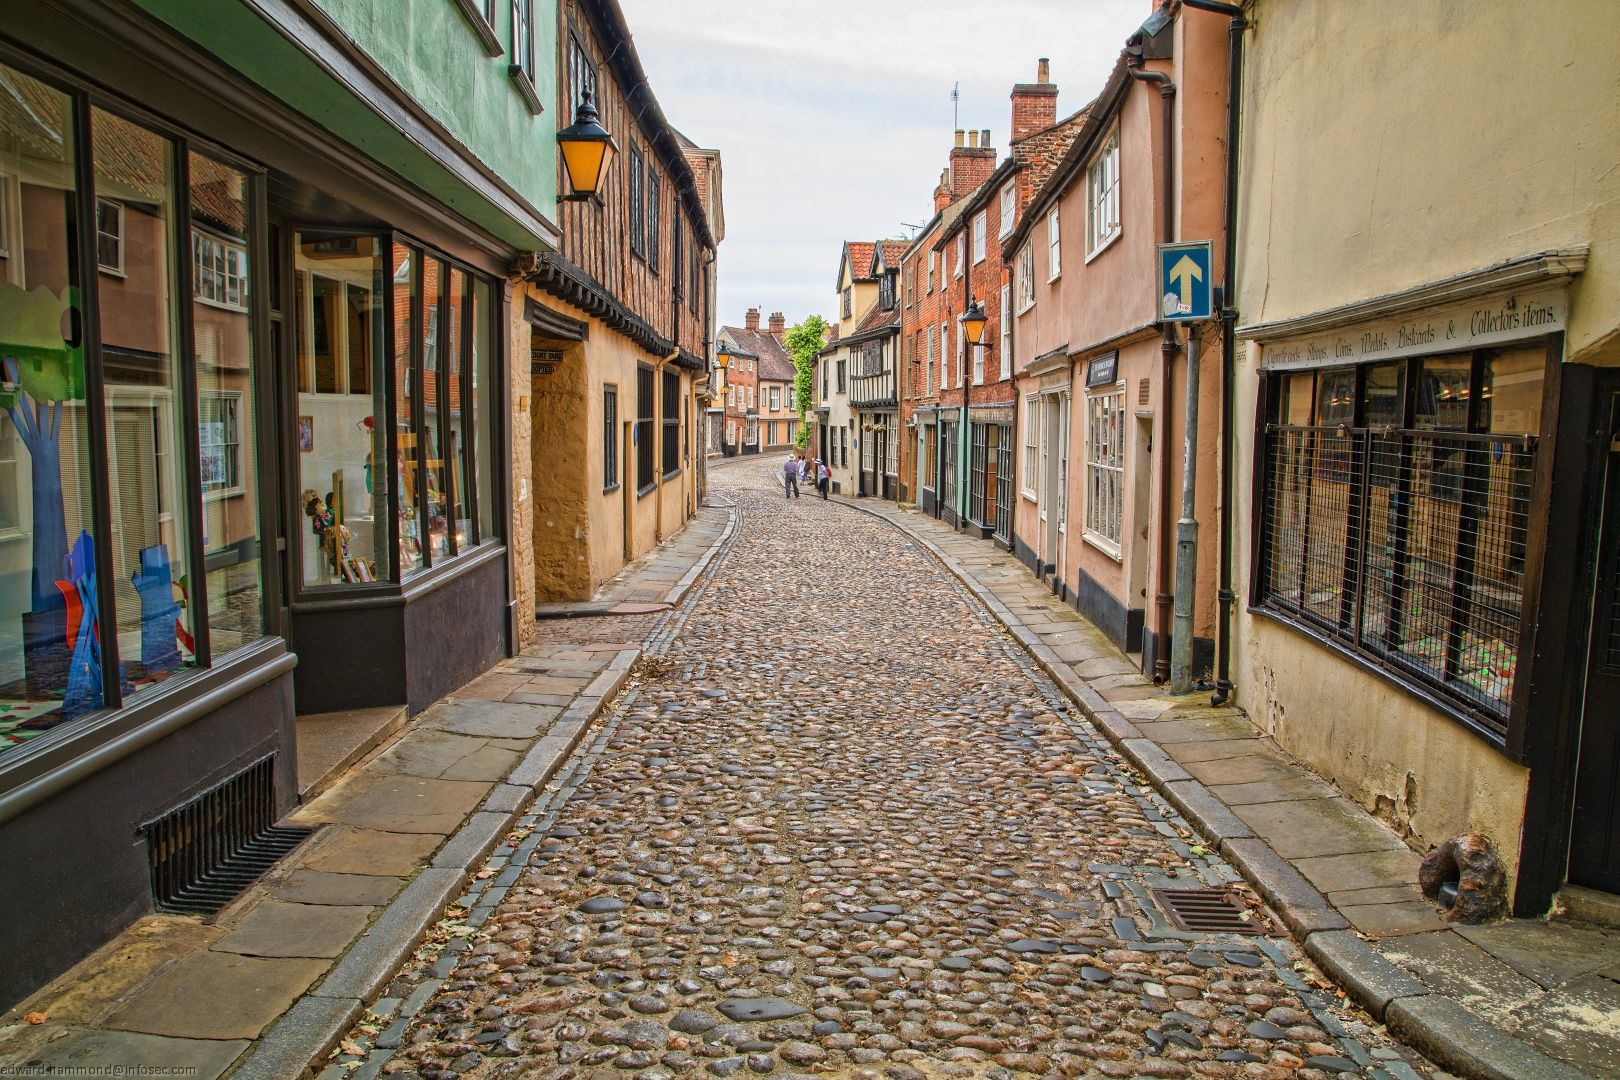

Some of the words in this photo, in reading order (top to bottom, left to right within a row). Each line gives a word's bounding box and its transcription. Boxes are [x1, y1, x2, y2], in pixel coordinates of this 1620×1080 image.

[1397, 324, 1436, 349] Postcards
[1446, 319, 1457, 340] &
[1470, 307, 1519, 338] Collectors
